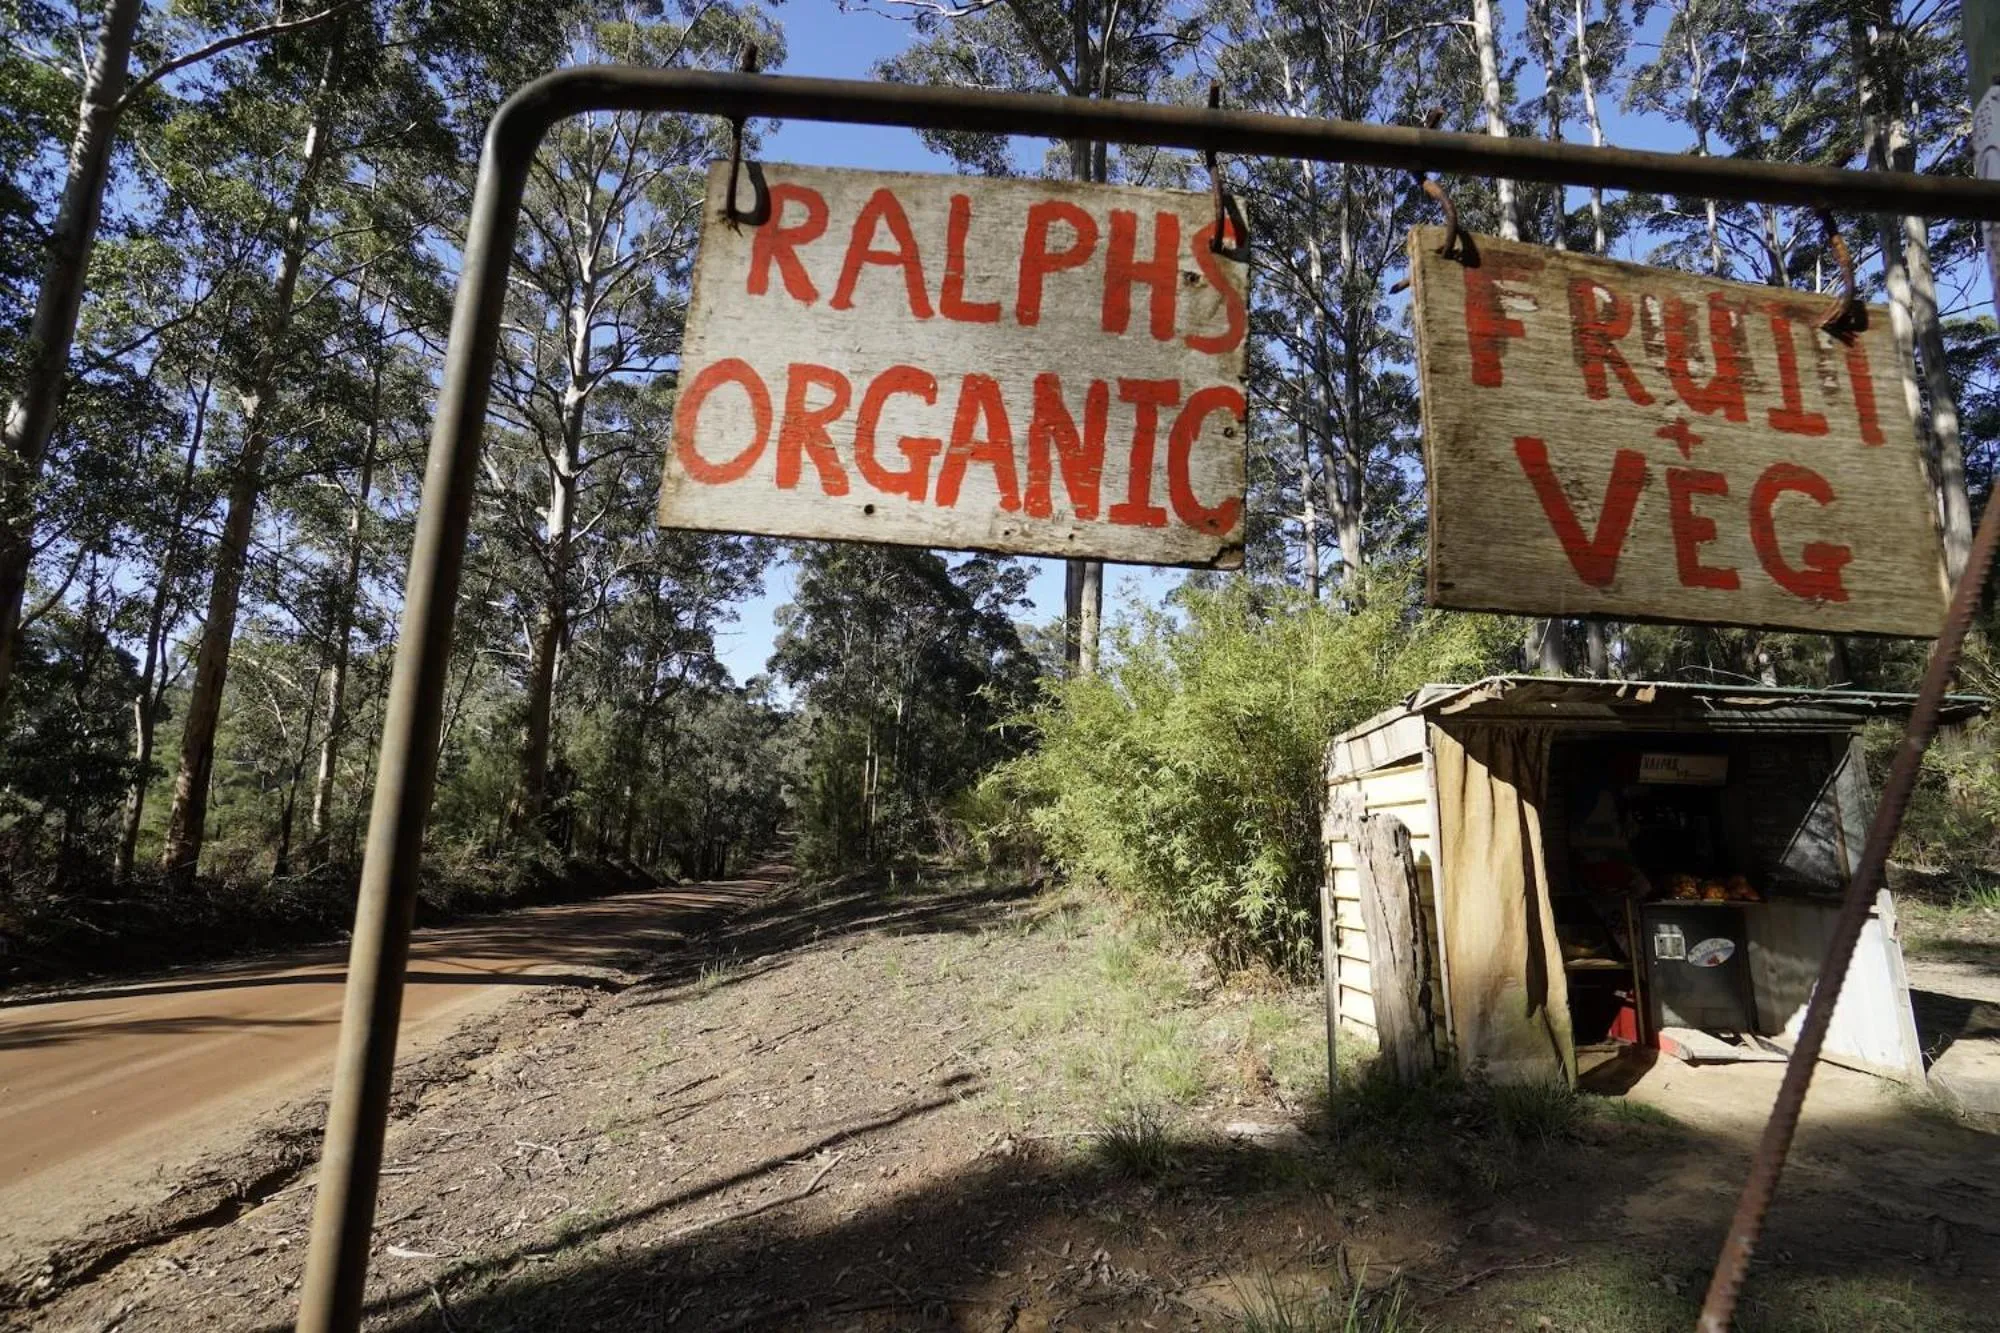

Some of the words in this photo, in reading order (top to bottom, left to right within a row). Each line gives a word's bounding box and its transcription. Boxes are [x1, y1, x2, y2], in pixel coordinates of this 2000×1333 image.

[747, 182, 1246, 354] RALPHS
[1463, 251, 1887, 447] FRUIT
[675, 357, 1246, 536] ORGANIC
[1513, 436, 1852, 601] VEG
